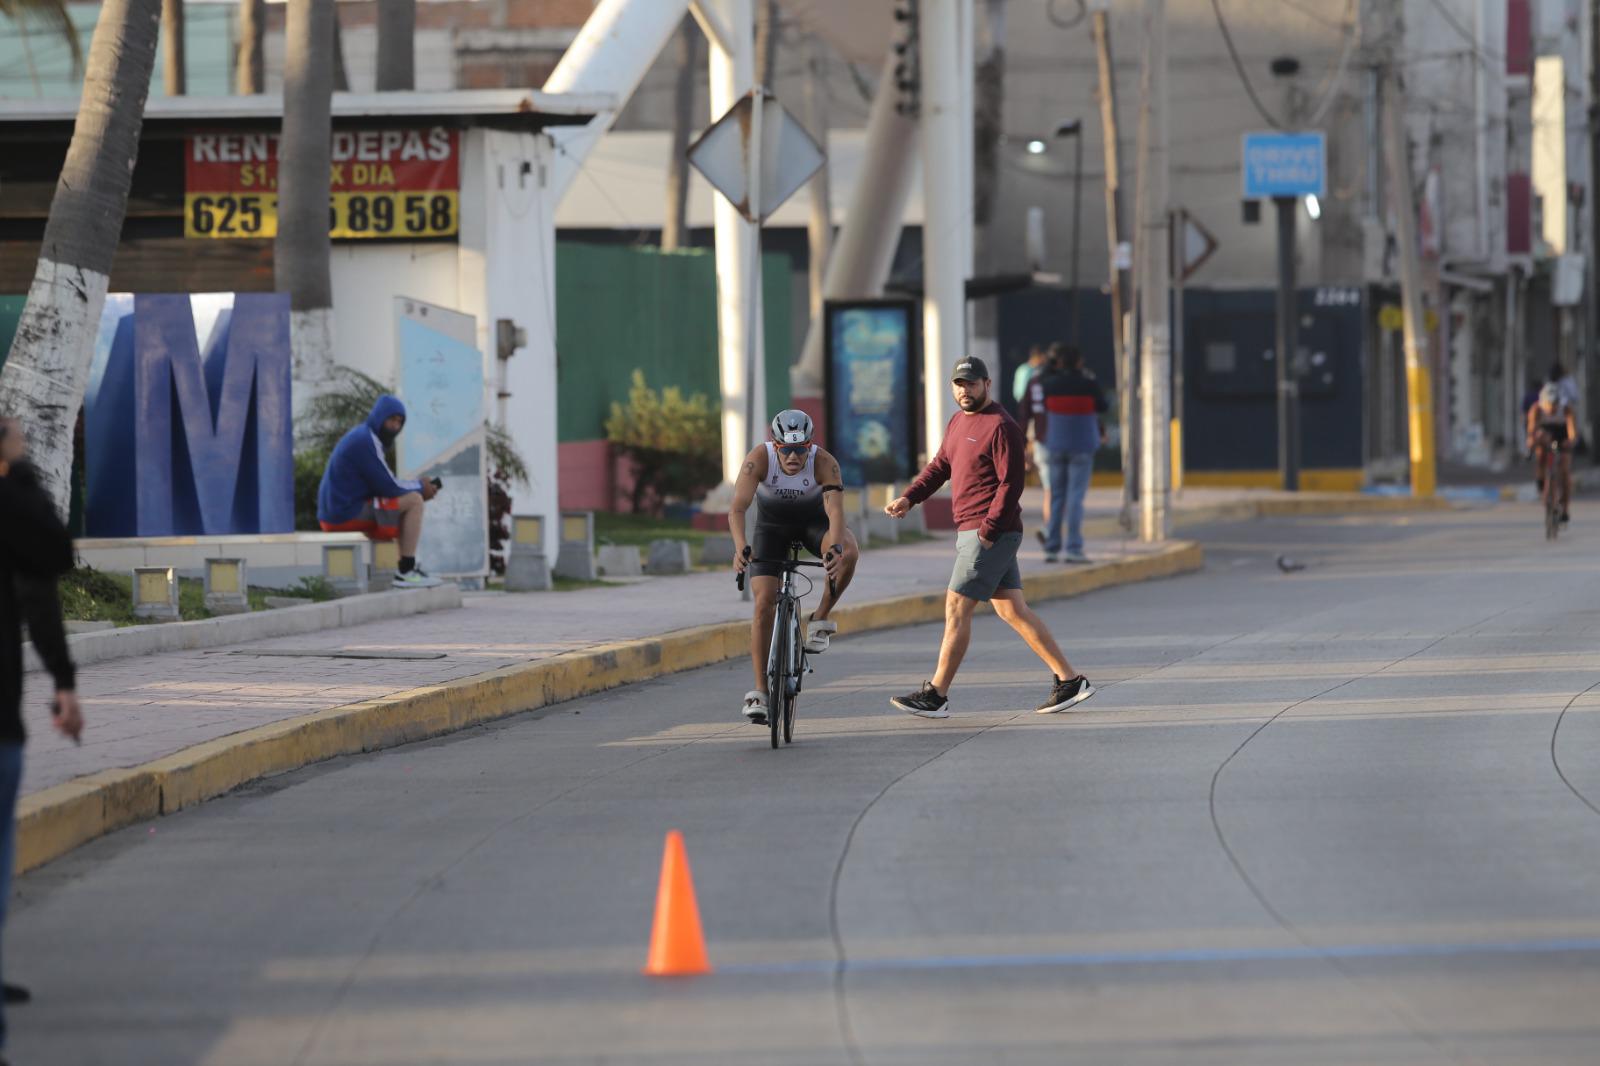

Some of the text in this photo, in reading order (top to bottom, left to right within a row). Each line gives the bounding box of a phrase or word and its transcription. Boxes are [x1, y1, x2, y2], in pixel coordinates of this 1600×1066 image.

[193, 127, 450, 162] RENT DEPAS
[1247, 145, 1318, 165] DRIVE
[352, 163, 395, 187] DIA
[1253, 166, 1318, 185] THRU
[192, 196, 262, 234] 625
[348, 195, 395, 233] 89
[405, 194, 451, 232] 58
[134, 292, 294, 536] M
